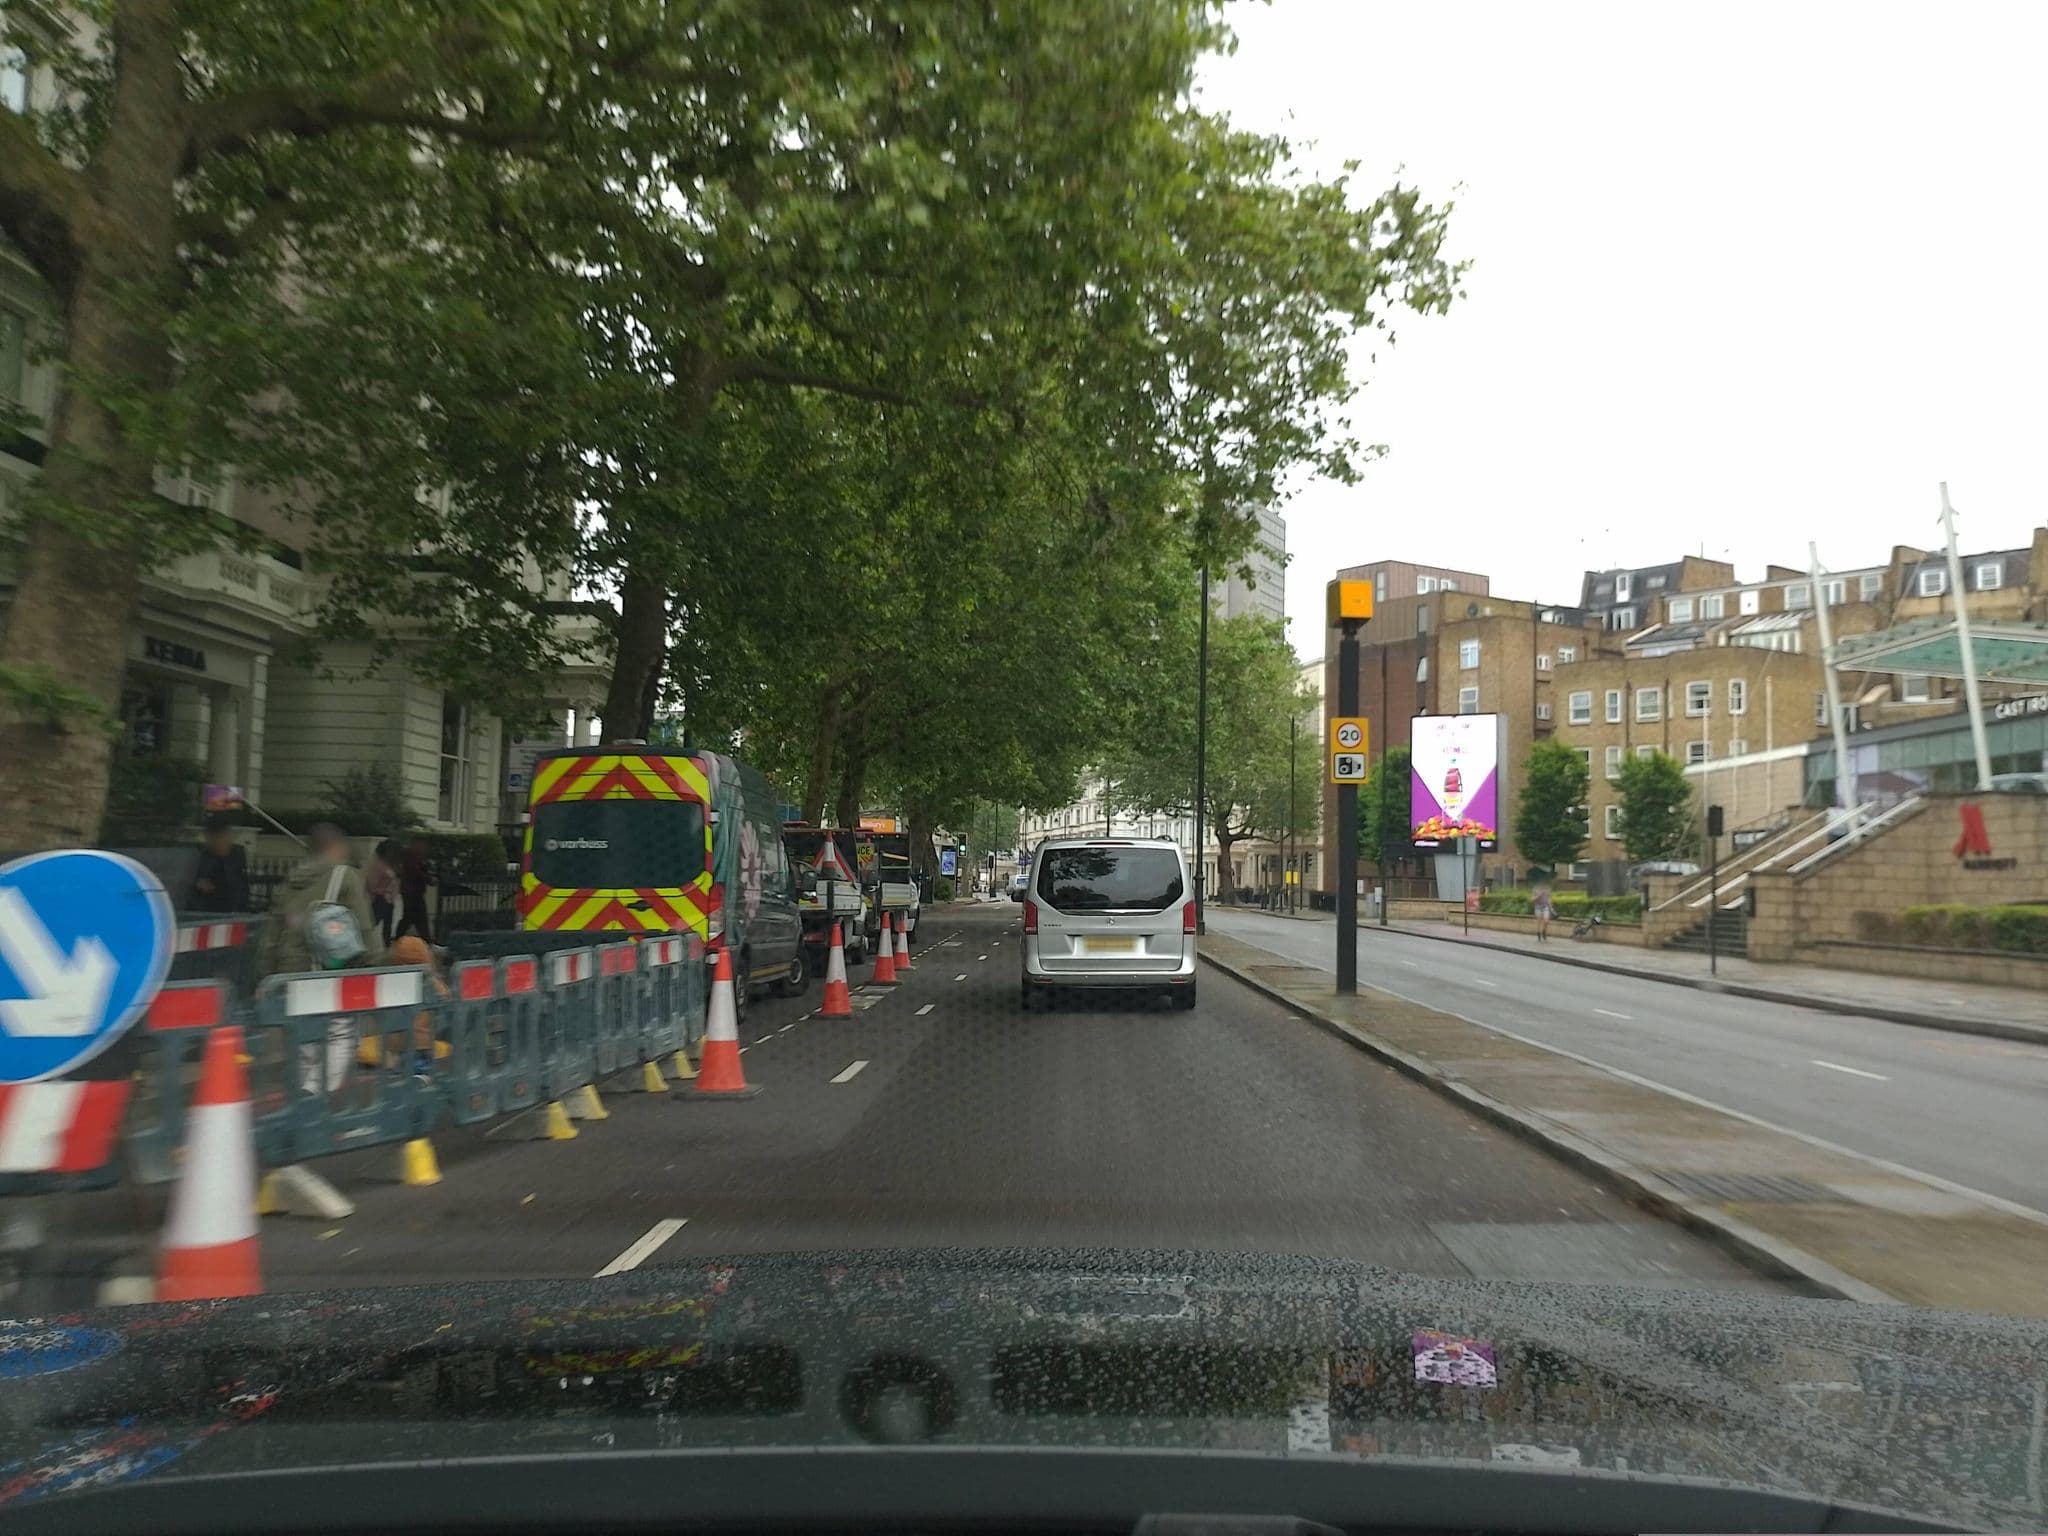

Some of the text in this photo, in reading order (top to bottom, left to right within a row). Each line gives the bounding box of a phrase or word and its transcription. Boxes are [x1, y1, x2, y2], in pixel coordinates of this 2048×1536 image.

[1995, 695, 2048, 719] CAST IRO
[1340, 730, 1360, 741] 20
